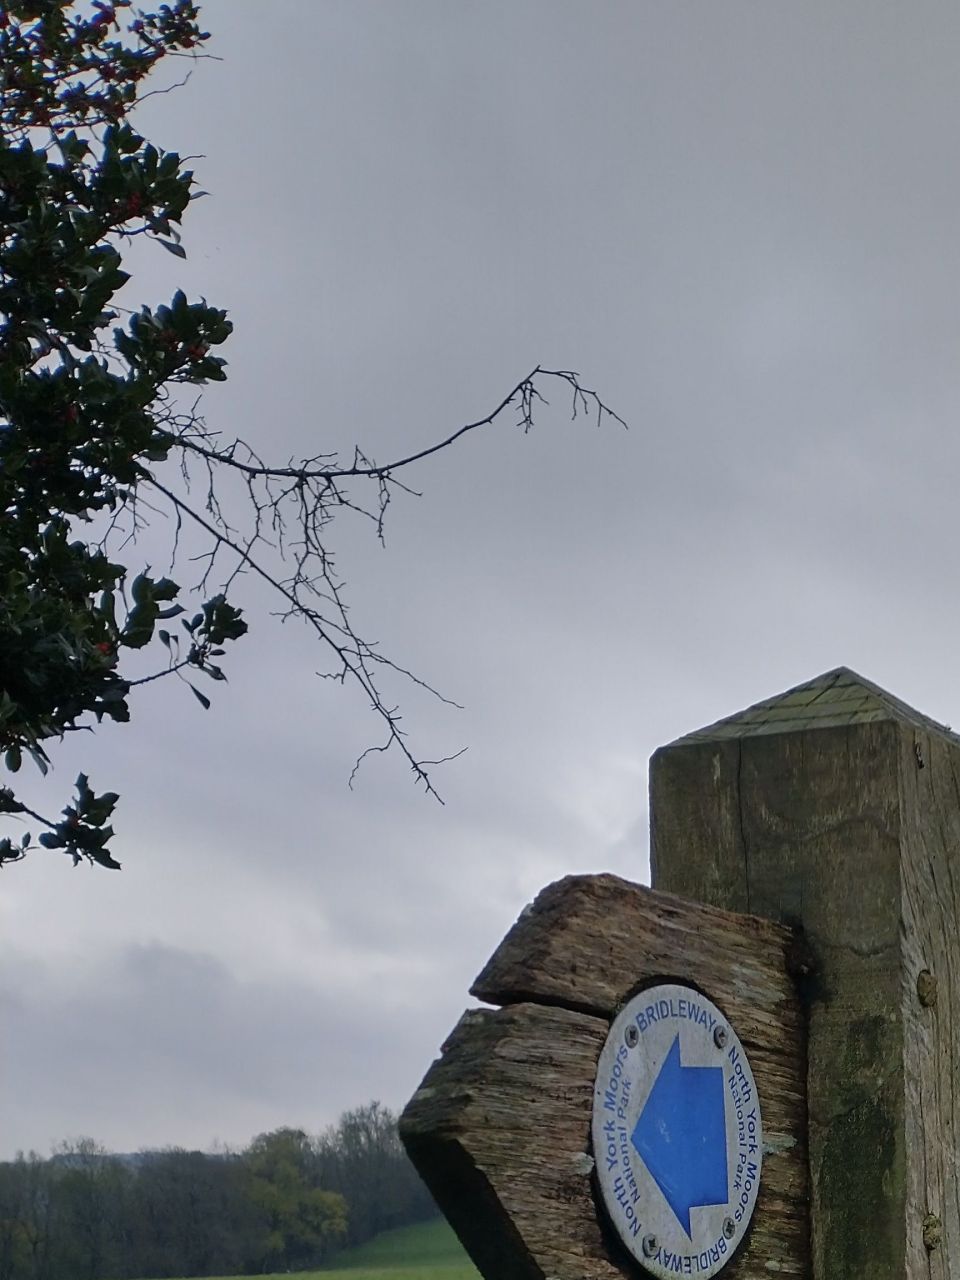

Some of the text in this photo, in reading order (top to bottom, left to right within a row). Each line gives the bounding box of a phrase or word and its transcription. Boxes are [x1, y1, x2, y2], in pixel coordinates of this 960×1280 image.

[635, 999, 718, 1033] BRIDLEWAY
[603, 1044, 643, 1238] North York Moors
[617, 1080, 641, 1205] National Park
[728, 1075, 747, 1191] National Park
[728, 1045, 759, 1223] North York Moors
[653, 1236, 728, 1274] BRIDLEWAY
